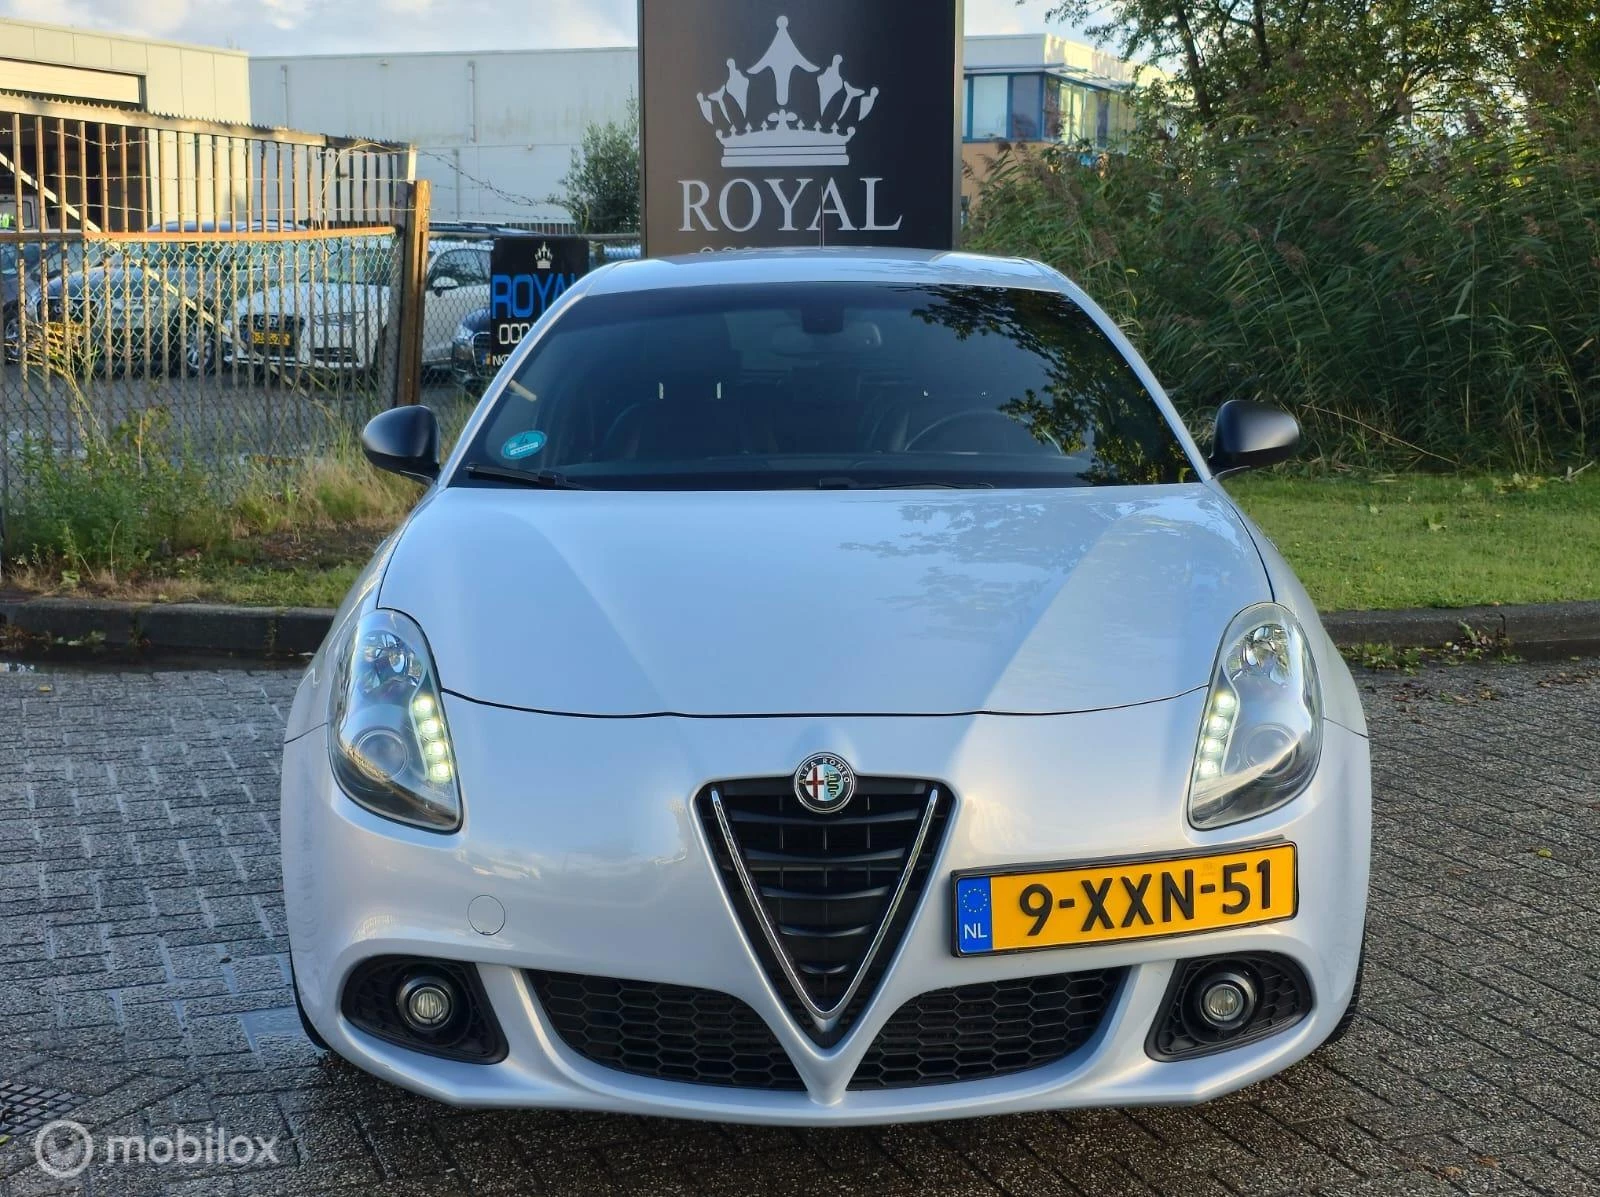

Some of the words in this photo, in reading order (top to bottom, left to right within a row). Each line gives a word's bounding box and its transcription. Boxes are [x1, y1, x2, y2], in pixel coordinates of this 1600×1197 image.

[677, 176, 903, 233] ROYAL
[491, 273, 577, 319] ROYA
[822, 757, 850, 783] ROMEO
[1019, 858, 1271, 937] 9-XXN-51
[963, 922, 988, 940] NL
